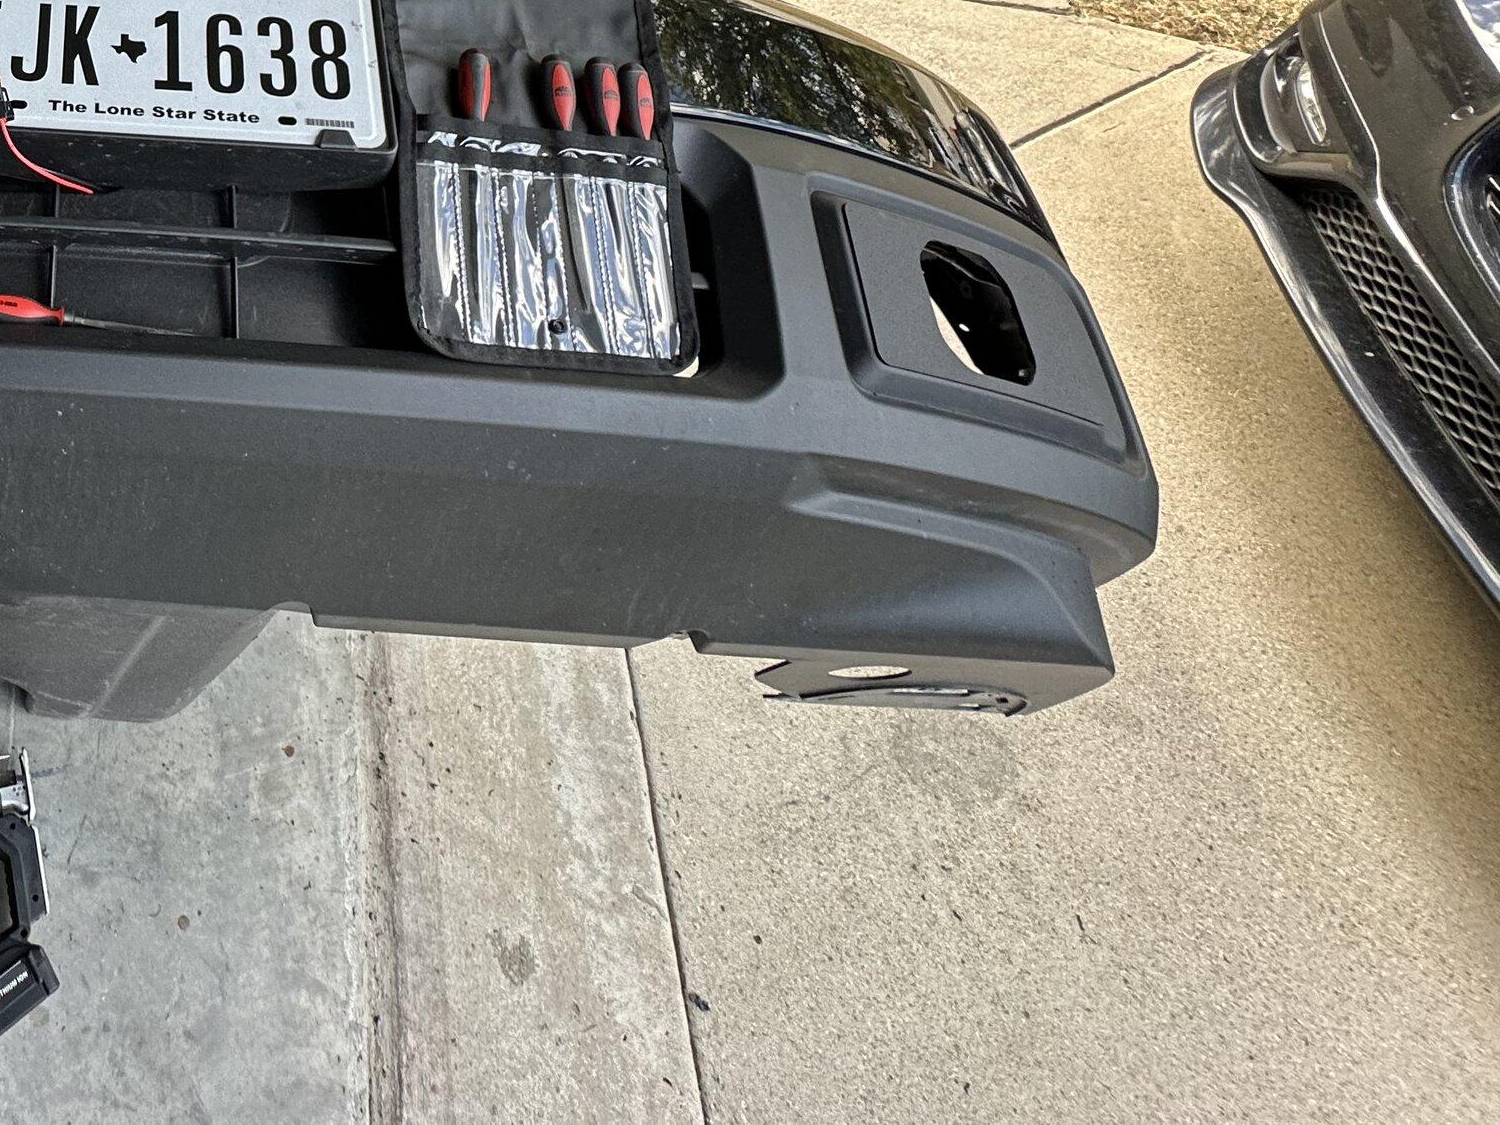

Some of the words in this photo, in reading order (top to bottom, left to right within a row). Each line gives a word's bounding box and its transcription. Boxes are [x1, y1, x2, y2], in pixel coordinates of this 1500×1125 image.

[153, 10, 352, 101] 1638
[48, 99, 87, 114] The
[94, 102, 145, 117] Lone
[152, 105, 197, 120] Star
[203, 108, 260, 124] State
[16, 970, 29, 983] ION
